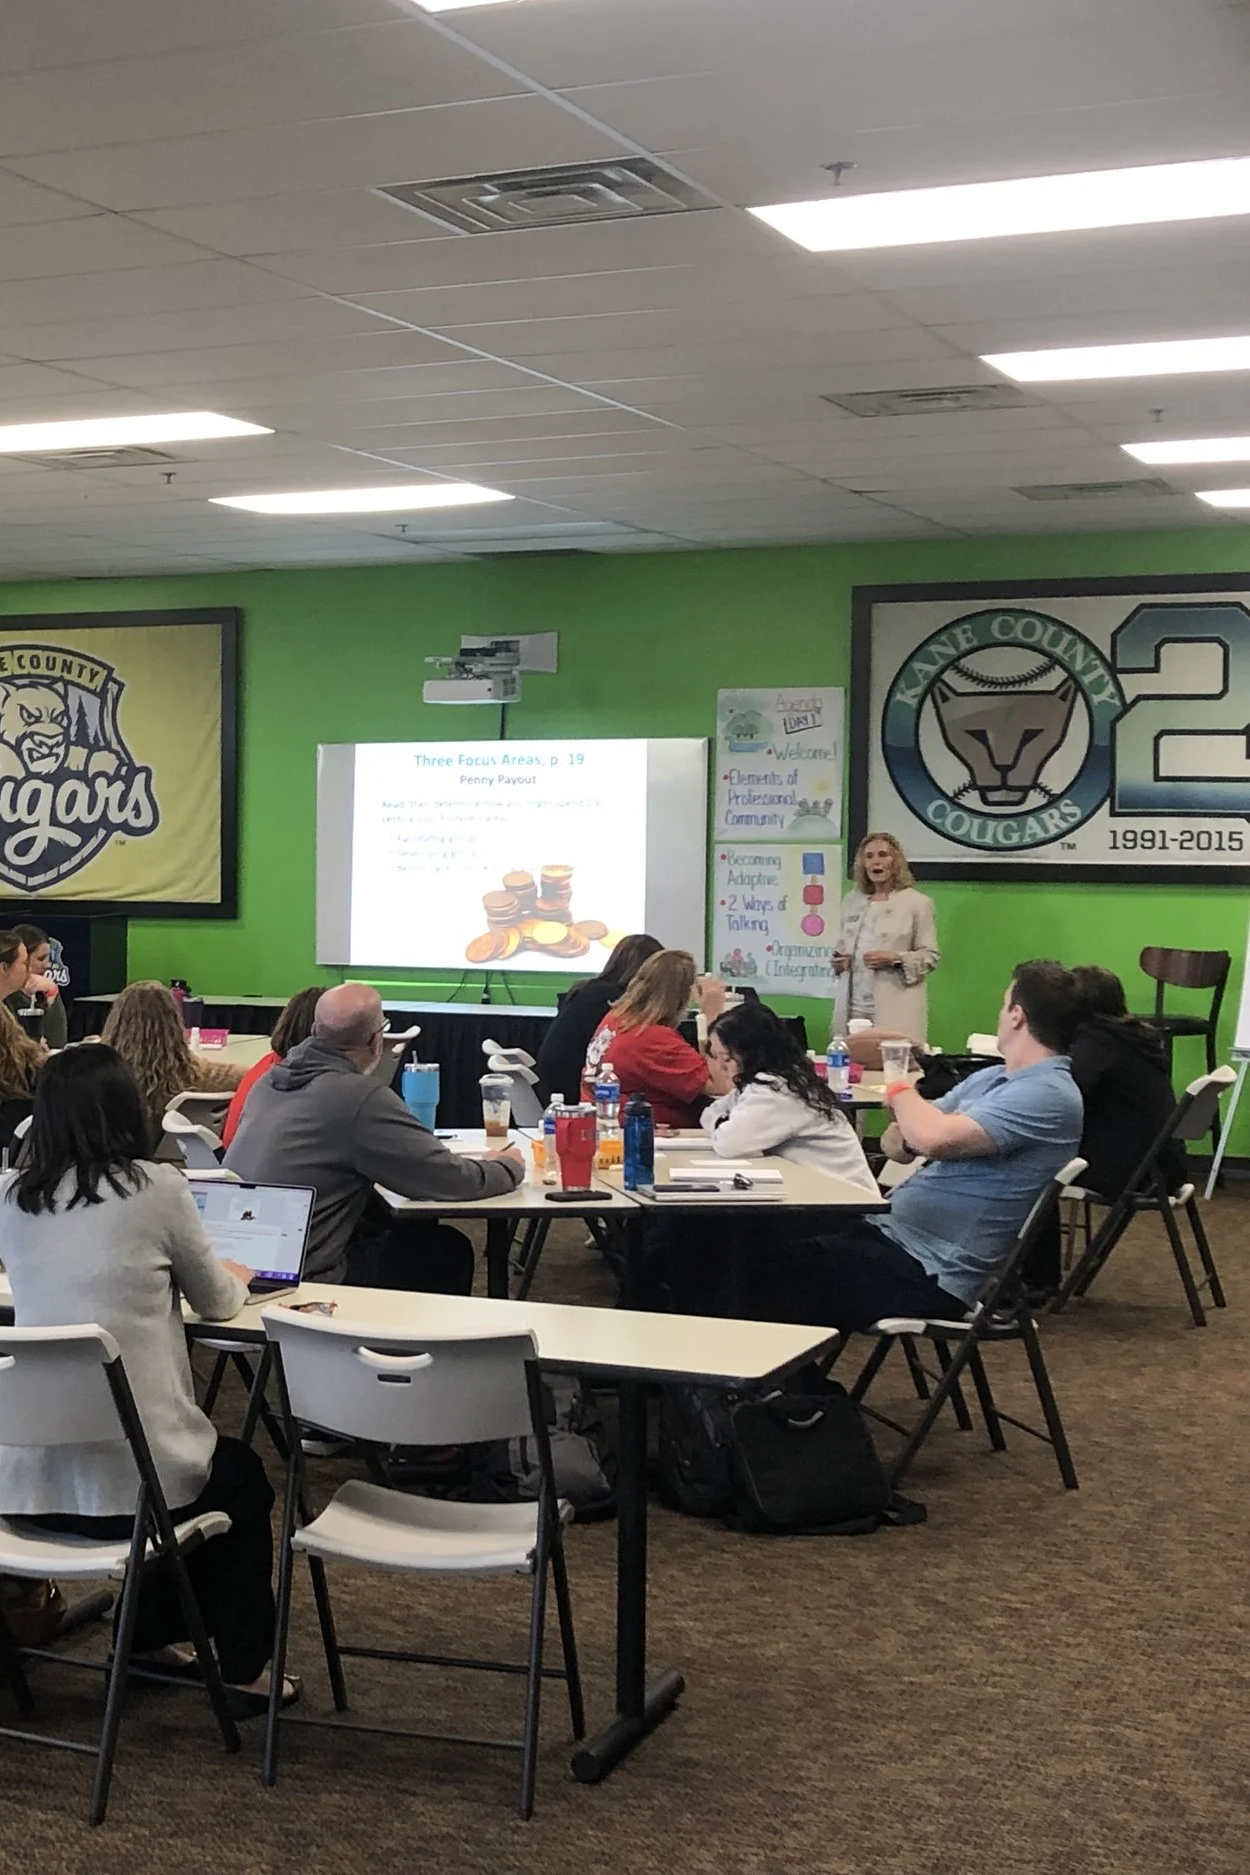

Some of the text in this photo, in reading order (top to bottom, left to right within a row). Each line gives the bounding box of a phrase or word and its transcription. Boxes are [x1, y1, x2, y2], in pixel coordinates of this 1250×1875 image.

[16, 654, 101, 684] COUNTY
[894, 615, 1122, 707] KANE COUNTY
[789, 715, 809, 729] DAY
[414, 752, 454, 767] Three
[458, 753, 497, 766] Focus
[501, 752, 545, 767] Areas,
[568, 752, 585, 765] 19
[772, 742, 838, 761] Welcome!
[459, 773, 537, 787] Penny Payout
[729, 768, 800, 786] Elements of
[727, 788, 798, 806] Professional
[725, 808, 785, 829] Community
[926, 799, 1082, 845] COUGARS
[1060, 842, 1077, 851] TM
[1109, 829, 1244, 851] 1991-2015
[727, 850, 782, 871] Becoming
[728, 893, 789, 916] 2 Ways of
[726, 913, 769, 937] Talking
[772, 939, 833, 961] Organizin
